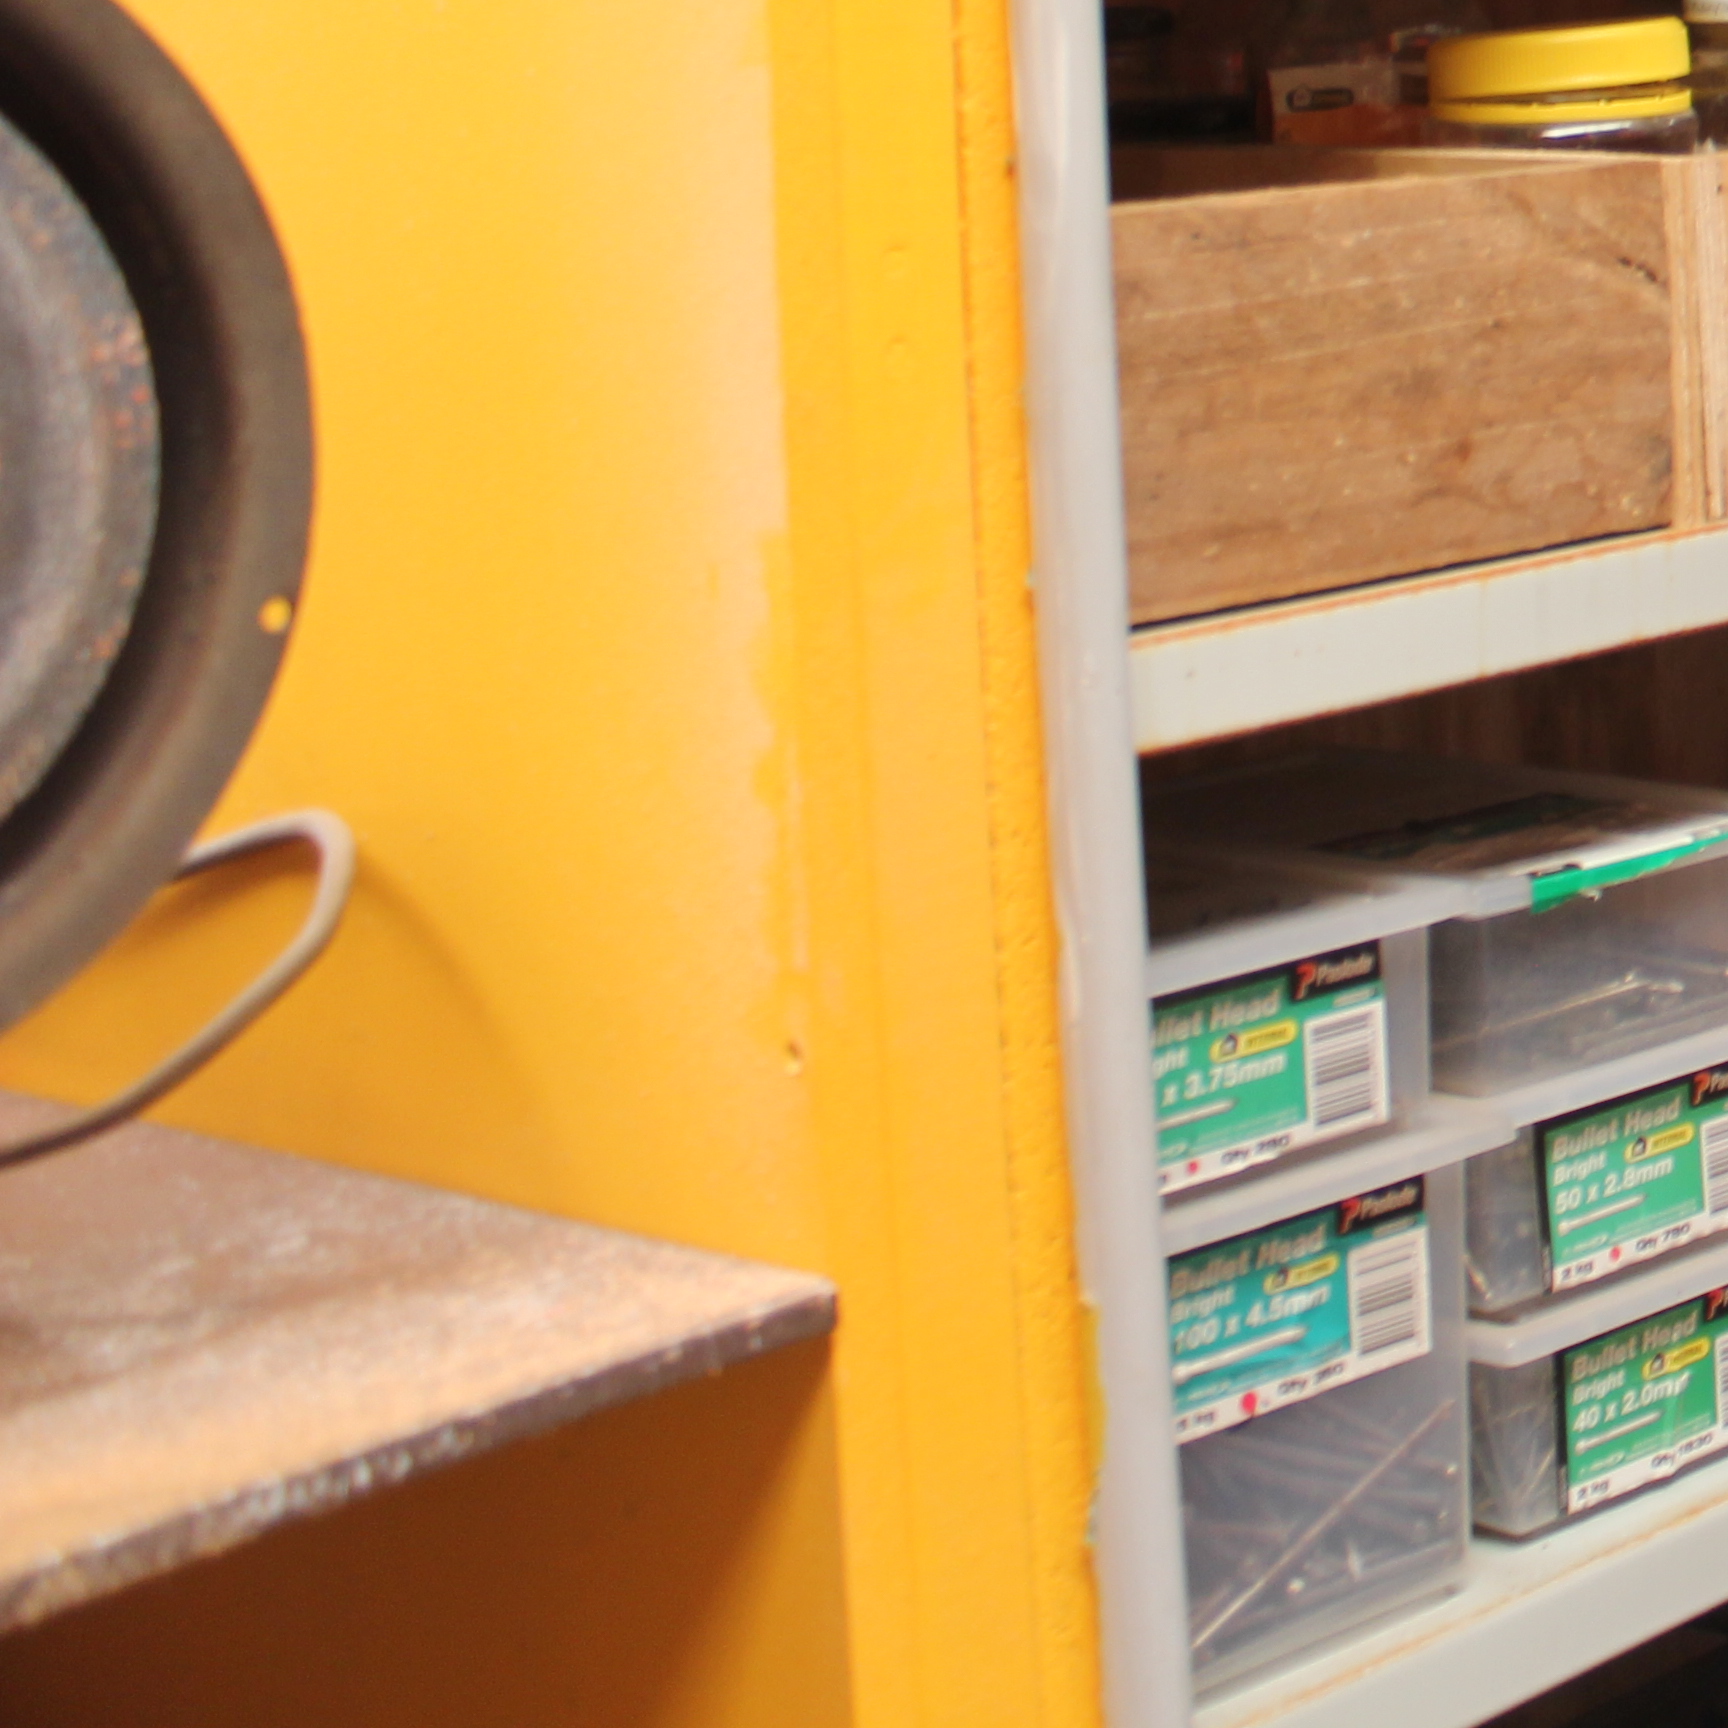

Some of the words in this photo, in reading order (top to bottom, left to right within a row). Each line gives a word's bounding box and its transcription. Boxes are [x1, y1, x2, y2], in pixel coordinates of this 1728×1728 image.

[1208, 984, 1282, 1033] Head
[1161, 1083, 1180, 1108] x
[1182, 1052, 1288, 1101] 3.75mm
[1551, 1120, 1619, 1163] Bullet
[1622, 1094, 1682, 1137] Head
[1552, 1149, 1608, 1188] Bright
[1554, 1185, 1583, 1216] 50
[1585, 1184, 1599, 1204] x
[1602, 1155, 1676, 1199] 2.8mm
[1169, 1247, 1250, 1301] Bullet
[1255, 1223, 1327, 1271] Head
[1634, 1235, 1659, 1254] Qty
[1169, 1284, 1237, 1325] Bright
[1173, 1317, 1223, 1355] 100
[1223, 1314, 1241, 1338] x
[1244, 1282, 1331, 1328] 4.5mm
[1571, 1335, 1637, 1385] Bullet
[1641, 1309, 1698, 1354] Head
[1571, 1368, 1627, 1408] Bright
[1572, 1402, 1601, 1434] 40
[1603, 1402, 1617, 1423] x
